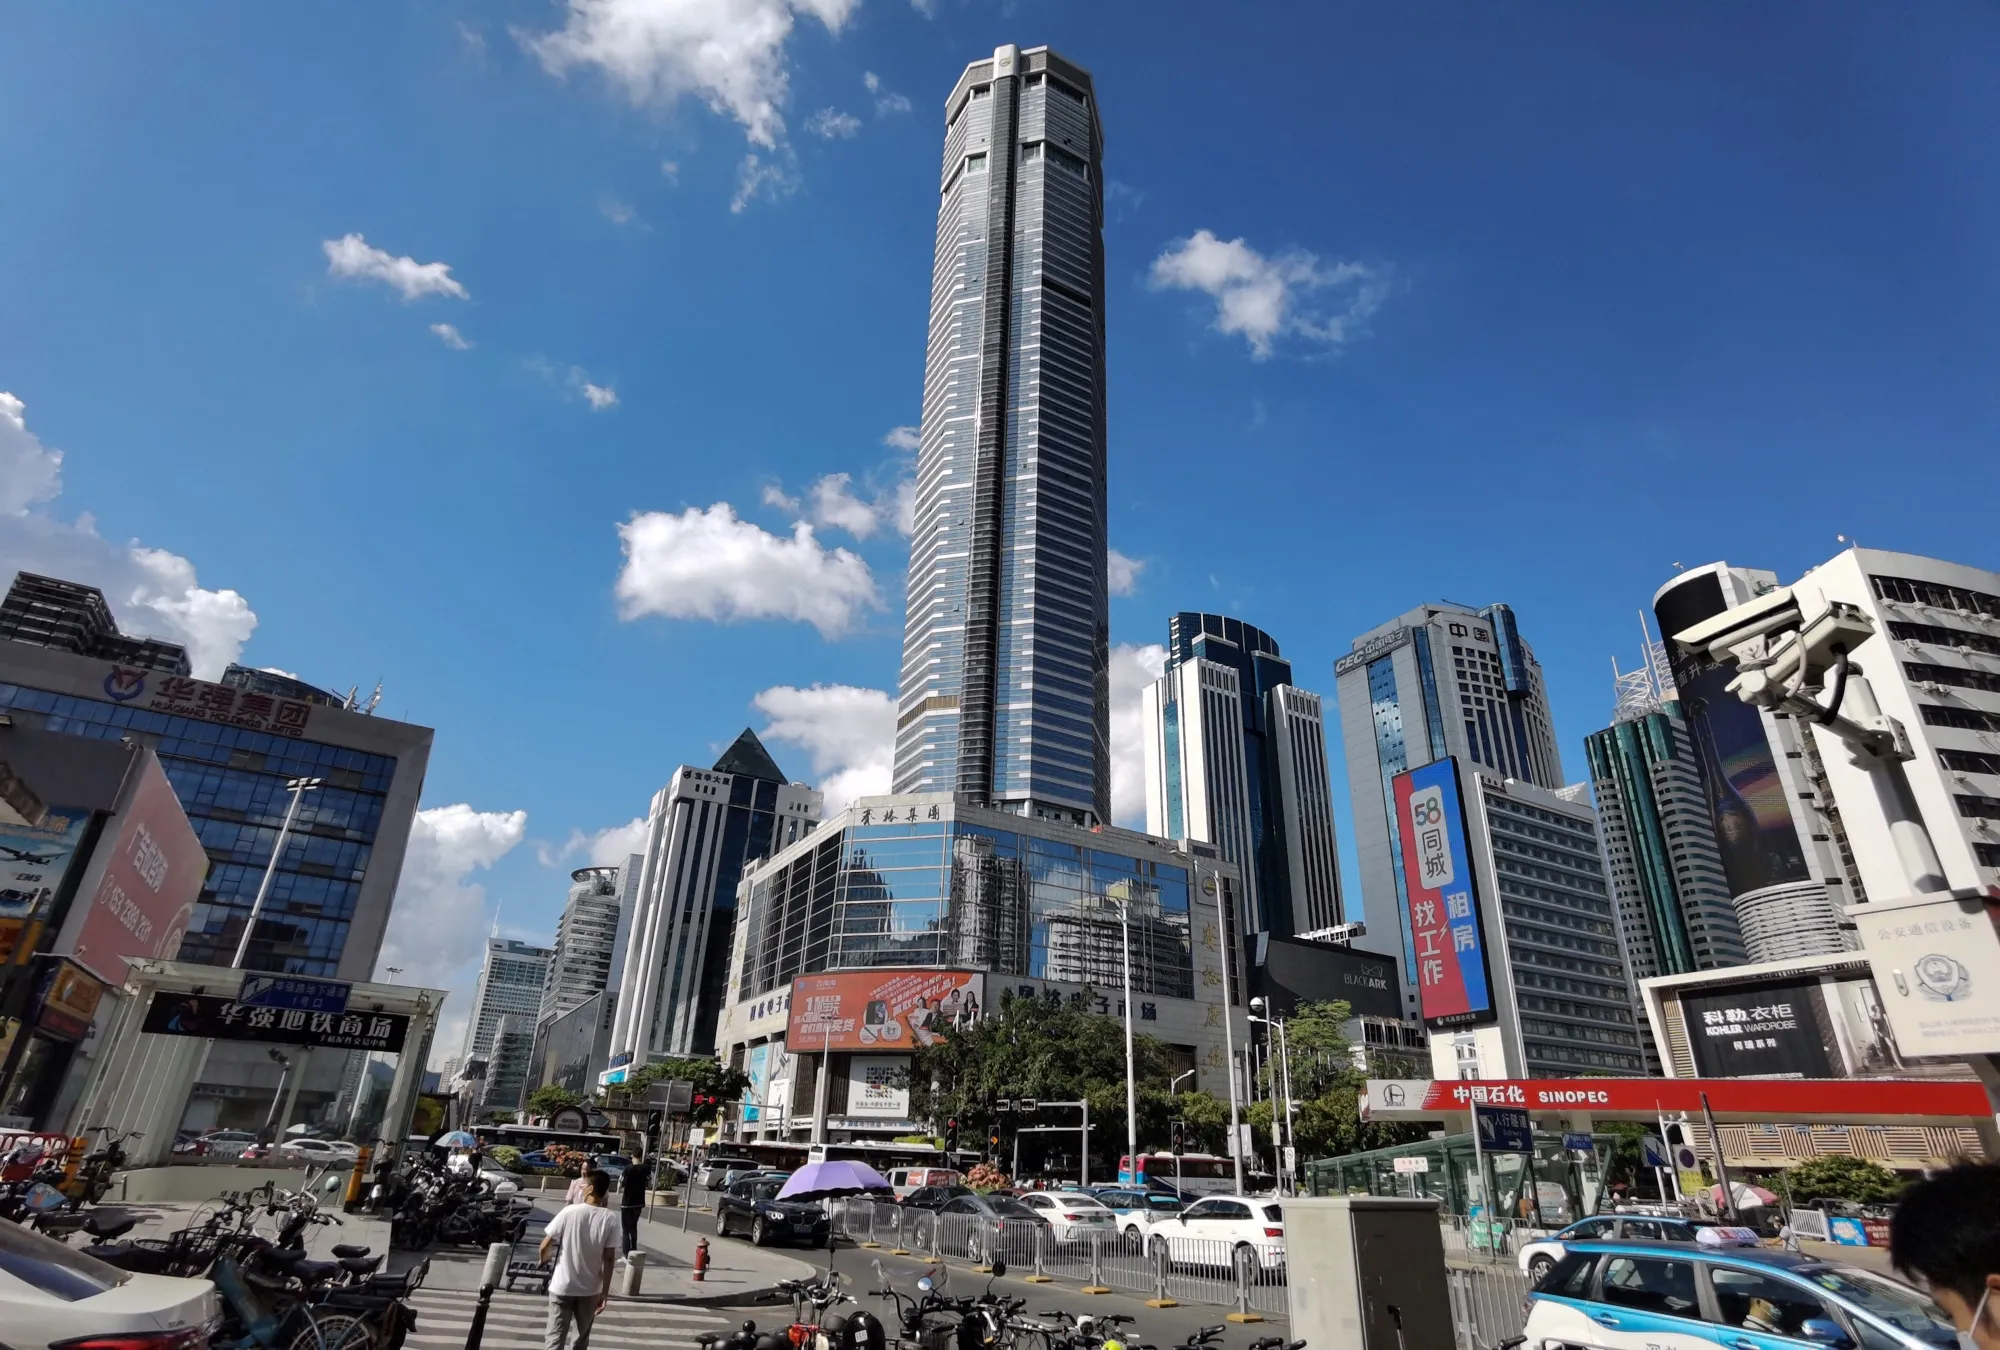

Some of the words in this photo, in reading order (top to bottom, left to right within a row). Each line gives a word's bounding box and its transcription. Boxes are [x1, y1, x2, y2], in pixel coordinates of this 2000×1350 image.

[1365, 627, 1405, 654] 中国电子
[1449, 622, 1490, 643] 中国
[1335, 650, 1364, 673] CEC
[156, 676, 312, 729] 华强集团
[150, 700, 206, 718] HUAQIANG
[209, 710, 262, 729] HOLDINGS
[266, 721, 304, 737] LIMITED
[15, 872, 42, 883] EMS
[1446, 891, 1475, 953] 租房
[1878, 917, 1972, 940] 公安通信设备
[1414, 900, 1444, 987] 找工作
[217, 1003, 392, 1039] 华强地铁商场
[1705, 1024, 1744, 1036] KOHLER
[1744, 1019, 1798, 1033] WARDROBE
[1452, 1085, 1525, 1104] 中国石化
[1538, 1090, 1609, 1103] SINOPEC
[1494, 1111, 1528, 1129] 人行隧道
